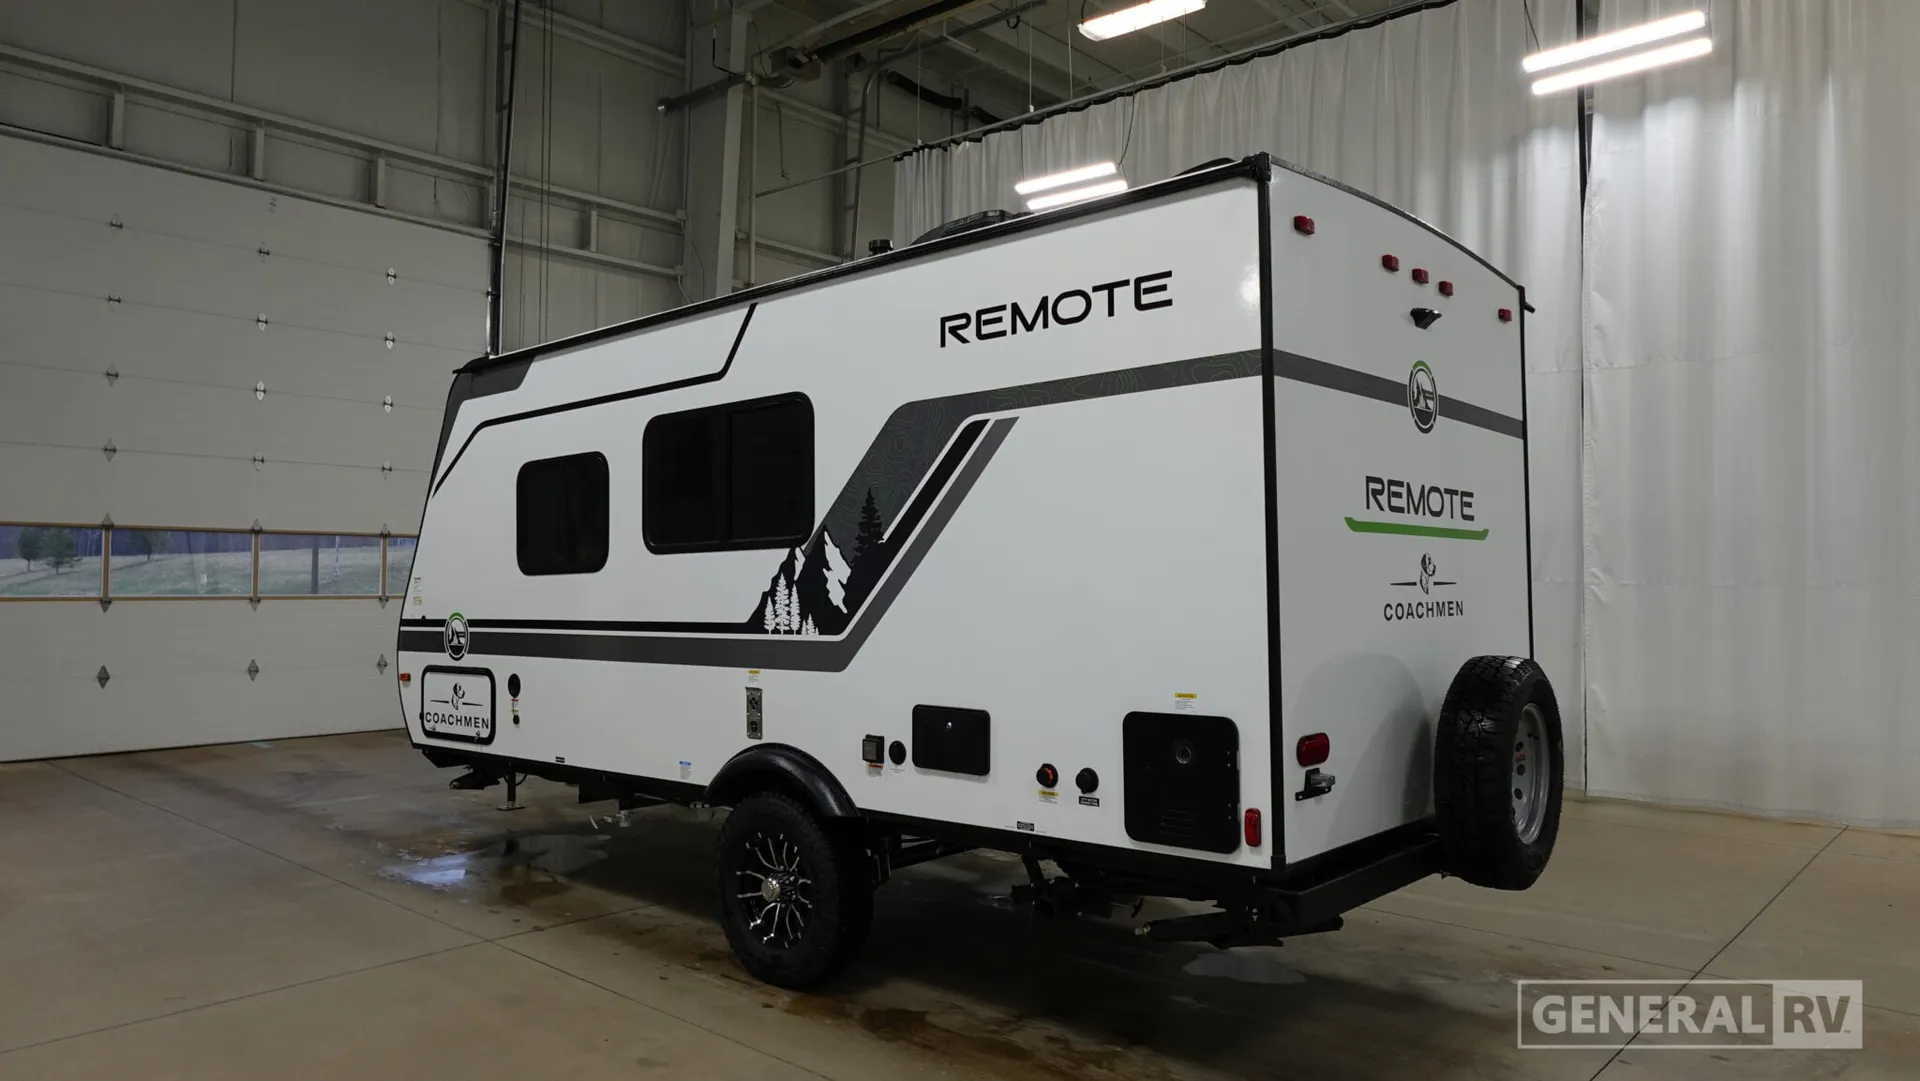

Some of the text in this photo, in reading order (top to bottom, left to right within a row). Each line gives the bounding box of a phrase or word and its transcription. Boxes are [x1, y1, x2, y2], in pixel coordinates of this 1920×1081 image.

[940, 270, 1173, 348] REMOTE
[1365, 475, 1475, 522] REMOTE
[1383, 600, 1464, 621] COACHMEN
[425, 711, 489, 729] COACHMEN
